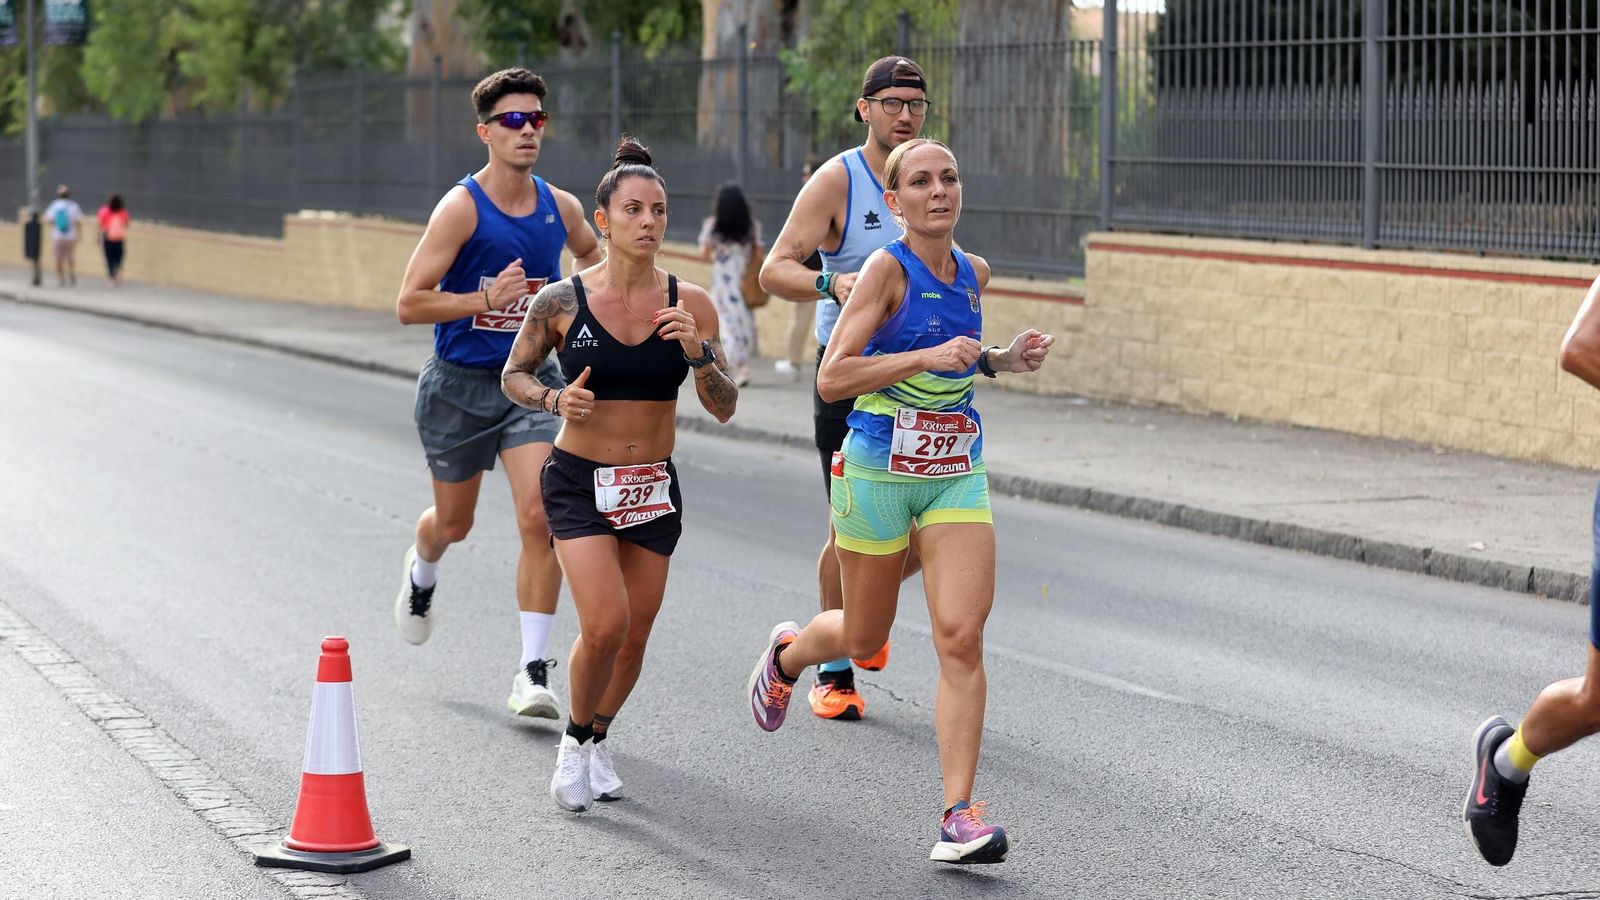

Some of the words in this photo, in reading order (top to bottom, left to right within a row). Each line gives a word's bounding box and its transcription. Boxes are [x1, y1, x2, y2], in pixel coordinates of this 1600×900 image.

[572, 340, 599, 348] ELITE
[922, 421, 945, 431] XXIX
[915, 434, 958, 456] 299
[621, 476, 642, 484] XXIX
[617, 485, 654, 508] 239
